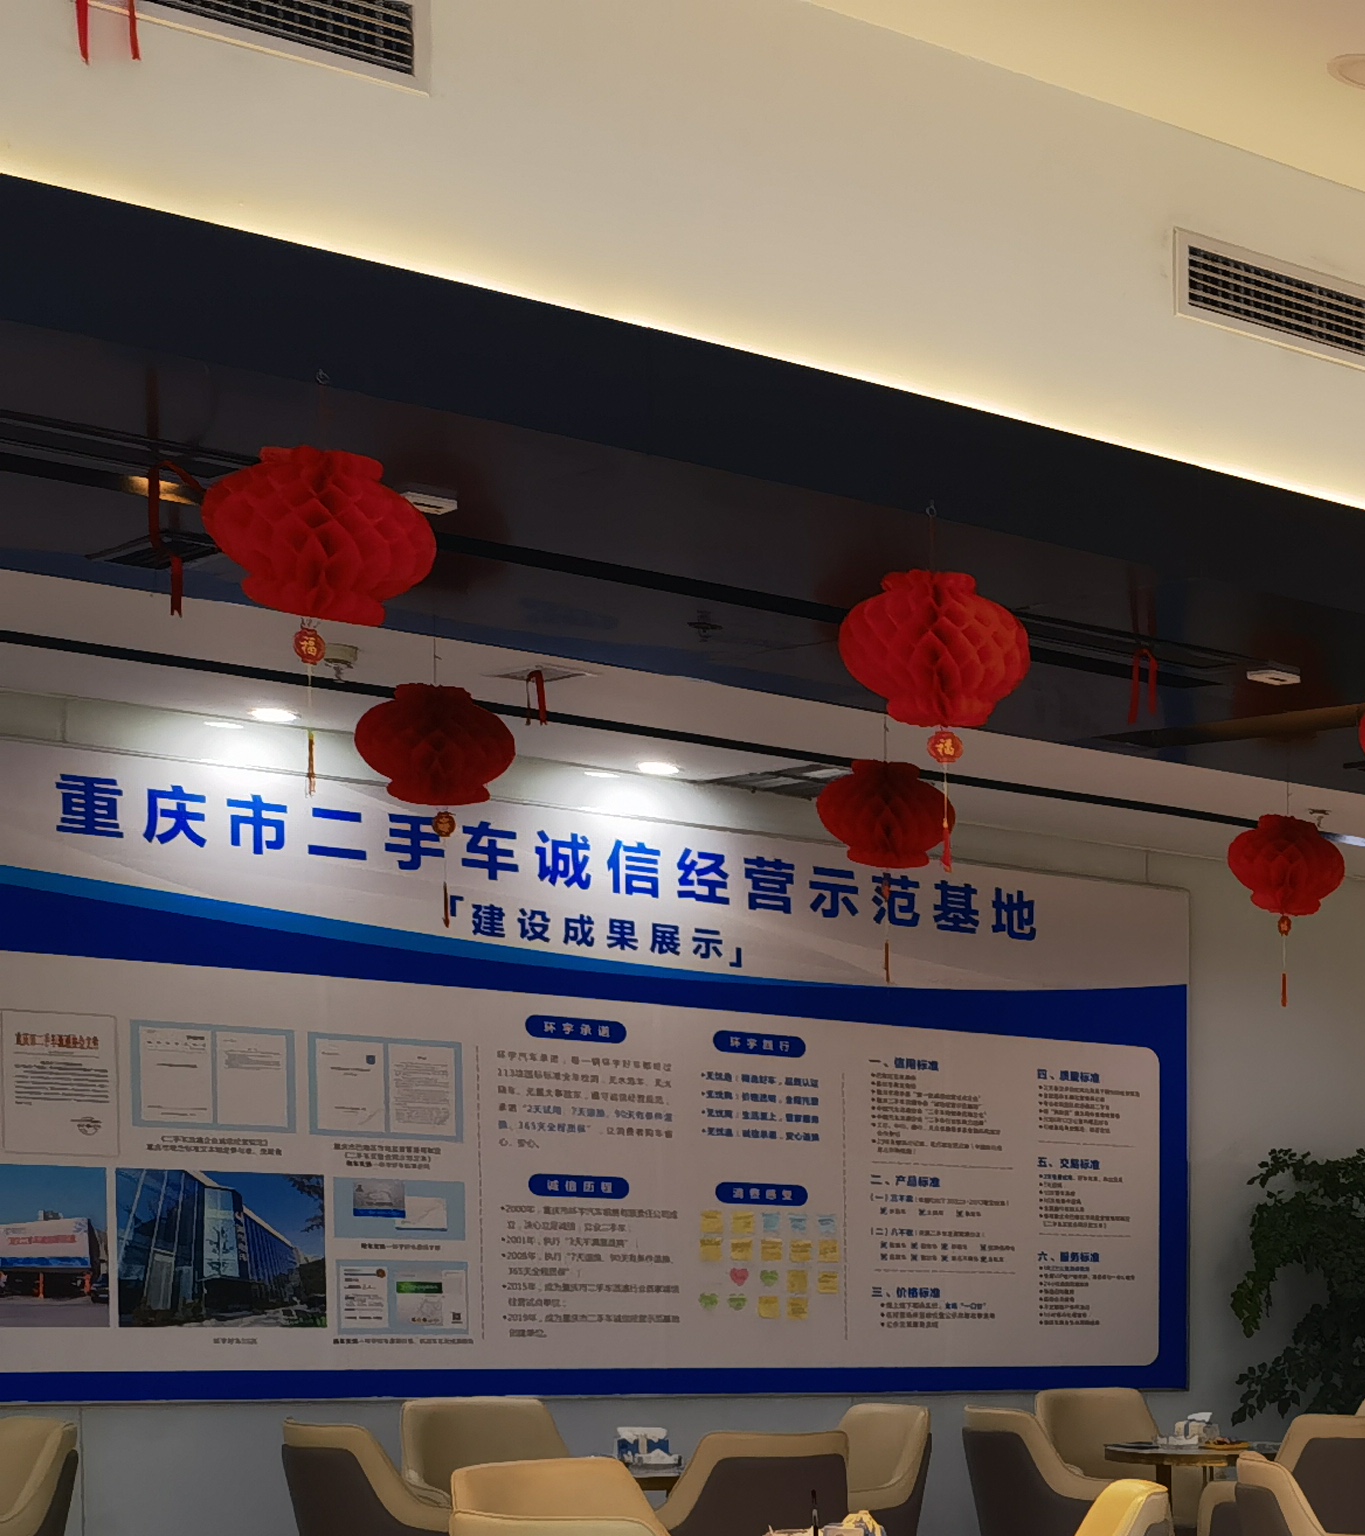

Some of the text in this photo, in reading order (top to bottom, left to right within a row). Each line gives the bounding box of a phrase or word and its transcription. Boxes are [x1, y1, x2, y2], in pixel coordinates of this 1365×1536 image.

[55, 773, 1037, 941] 重庆市二手车诚信经营示范基地
[868, 1056, 940, 1072] 一、信用标准
[1037, 1068, 1100, 1083] 四、质量标准
[1037, 1156, 1100, 1170] 五、交易标准
[870, 1174, 941, 1188] 二、产品标准
[1037, 1251, 1100, 1263] 六、服务标准
[871, 1286, 941, 1299] 三、价格标准
